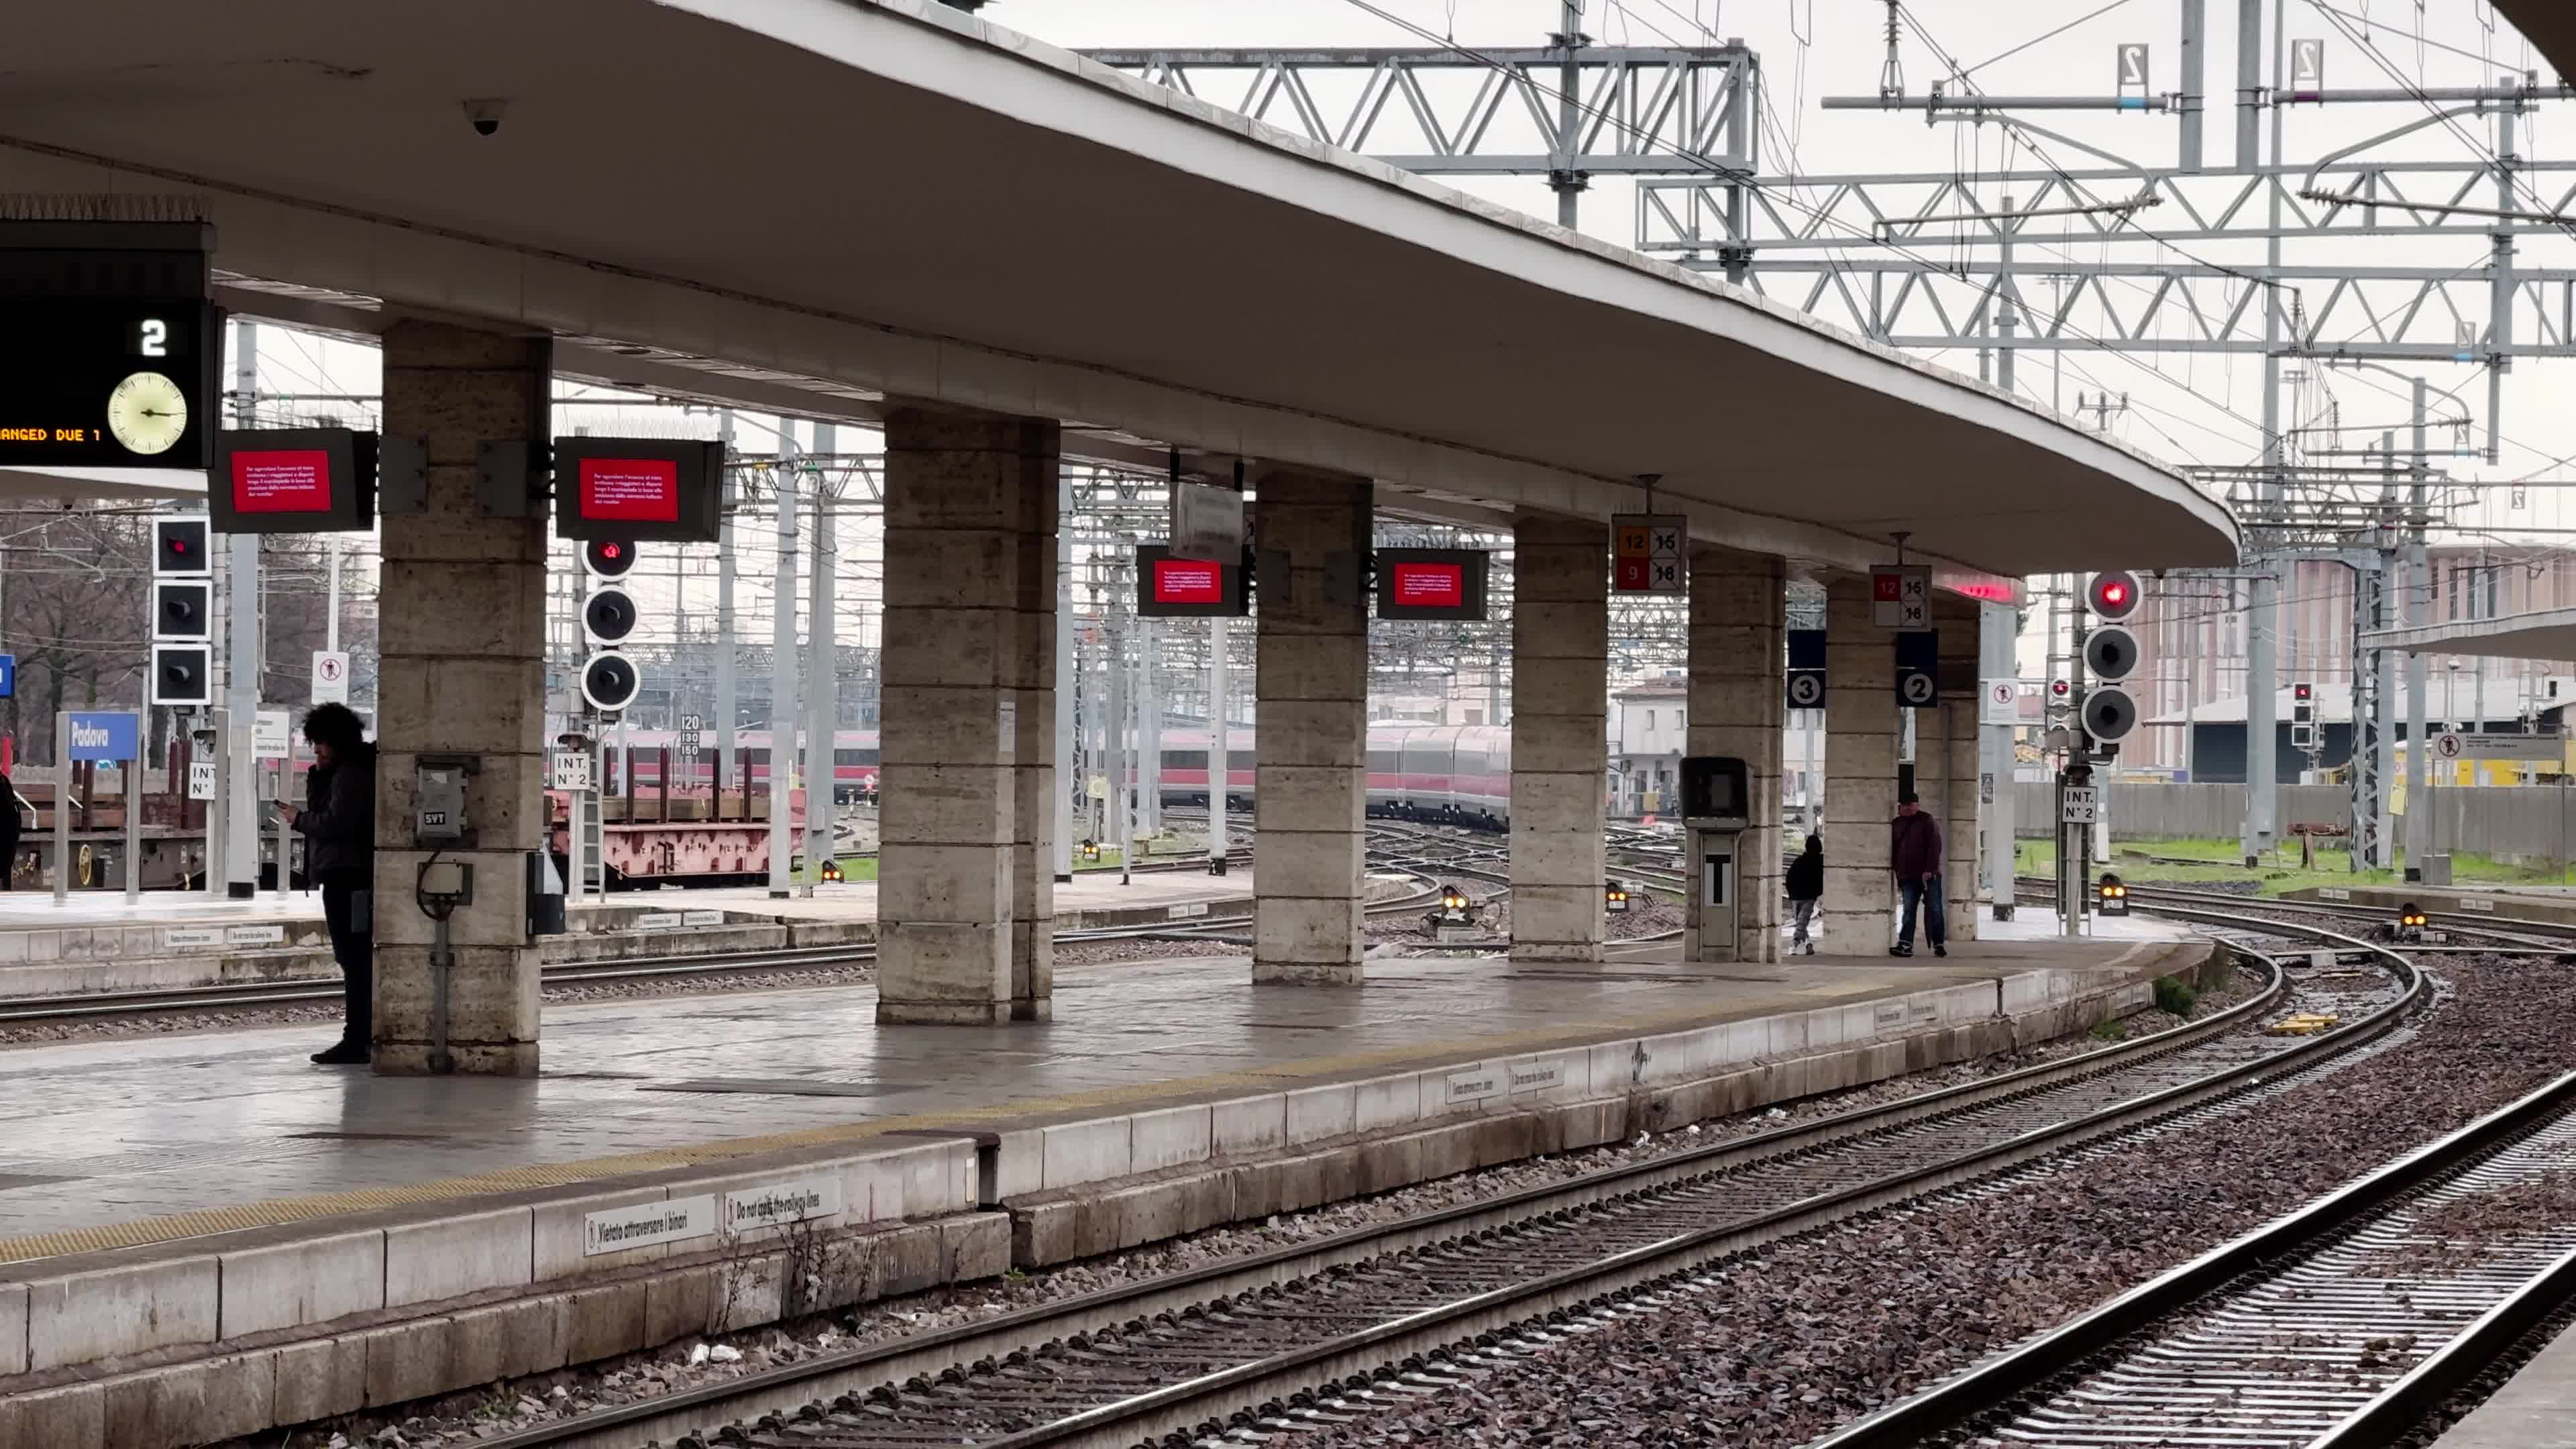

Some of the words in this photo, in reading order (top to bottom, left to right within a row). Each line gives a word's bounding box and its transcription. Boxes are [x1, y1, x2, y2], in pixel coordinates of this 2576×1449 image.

[142, 319, 166, 356] 2
[0, 429, 47, 441] ANGED
[56, 429, 85, 441] DUE
[1625, 535, 1644, 549] 12
[1656, 535, 1676, 549] 15
[1628, 566, 1638, 580] 9
[1880, 582, 1895, 594] 12
[1799, 680, 1813, 699] 3
[1912, 678, 1927, 698] 2
[682, 716, 700, 731] 120
[72, 720, 108, 747] Padova
[682, 733, 698, 743] 130
[682, 745, 698, 755] 150
[557, 758, 586, 769] INT.
[579, 773, 586, 785] 2
[2066, 791, 2093, 803] INT.
[425, 814, 444, 824] SVT
[2085, 808, 2092, 818] 2
[1705, 855, 1731, 904] T
[737, 1201, 745, 1220] Do
[747, 1201, 757, 1219] not
[598, 1223, 623, 1243] Vietato
[625, 1218, 663, 1240] attraversare
[669, 1210, 688, 1230] binari
